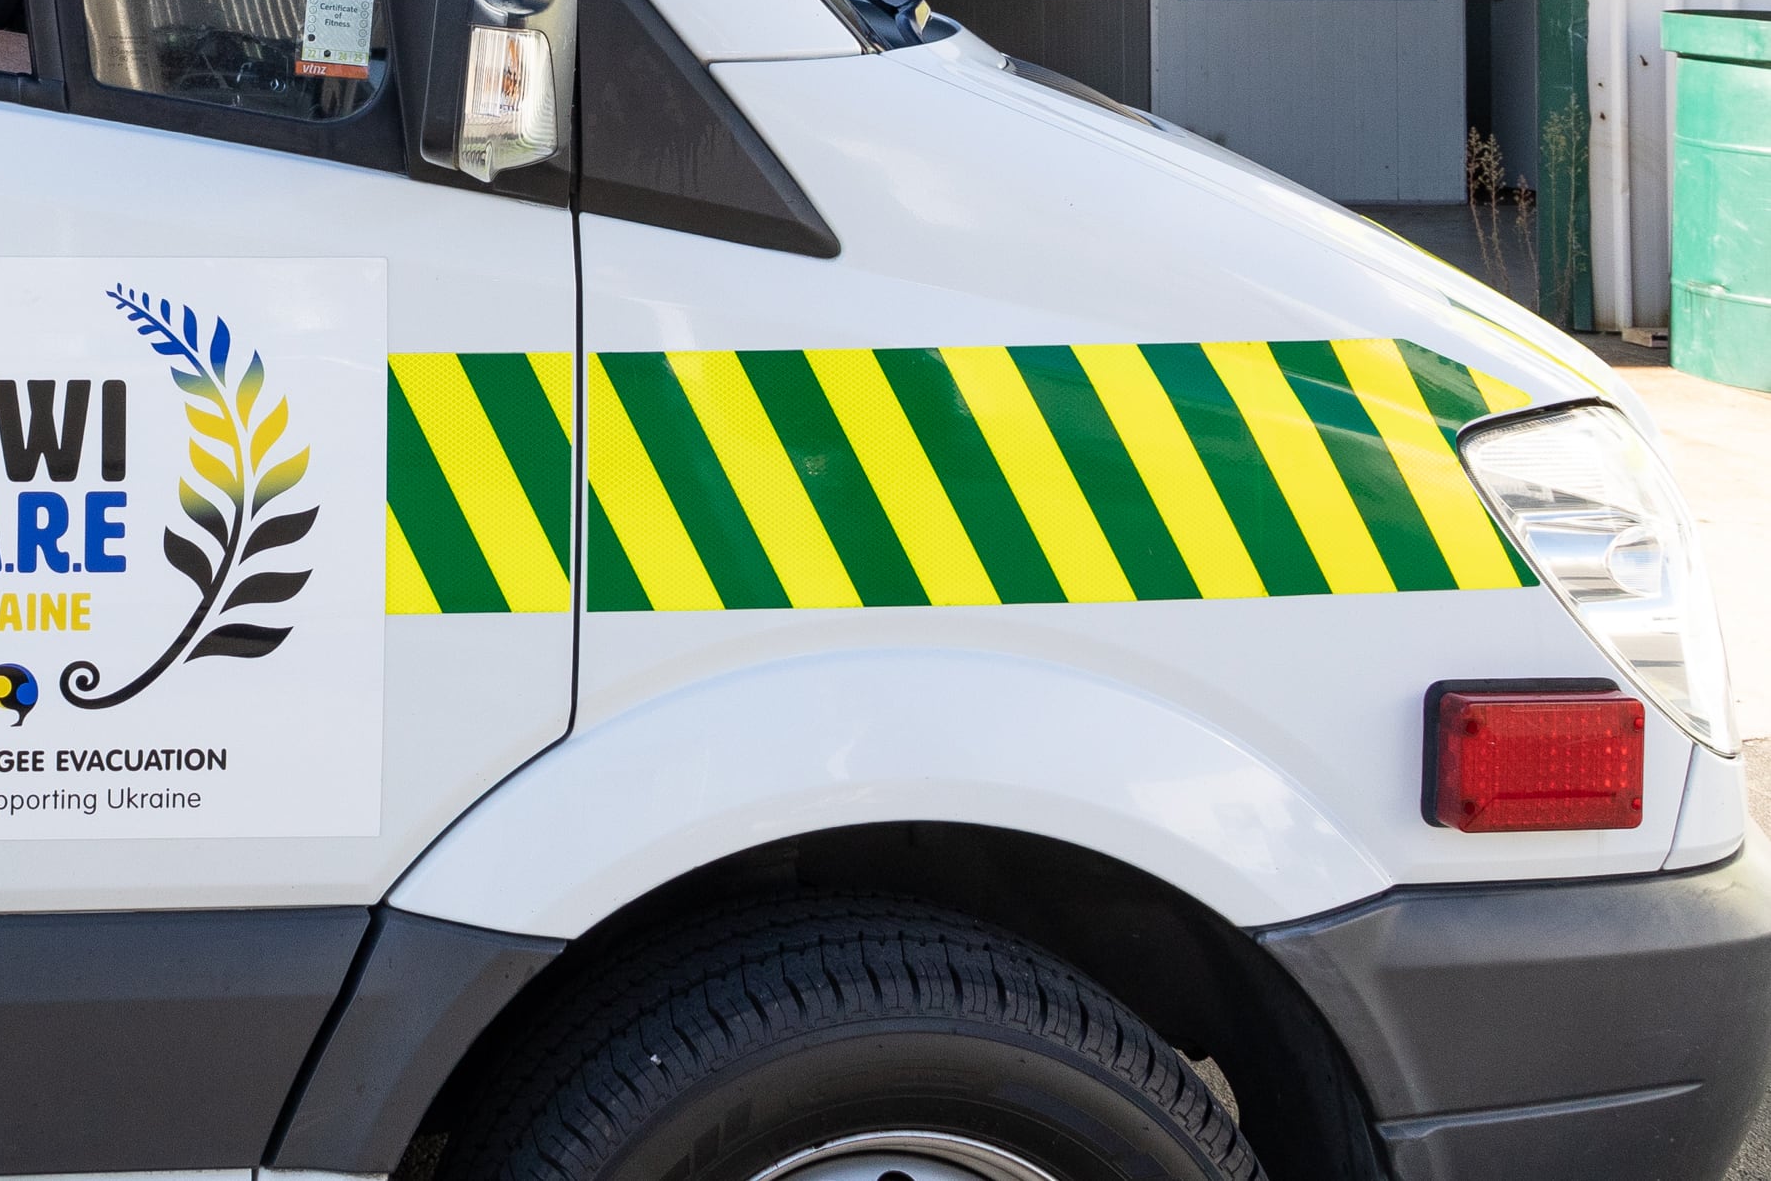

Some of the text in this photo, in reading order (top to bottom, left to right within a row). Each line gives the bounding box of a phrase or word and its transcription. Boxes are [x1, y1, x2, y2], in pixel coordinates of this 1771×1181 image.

[320, 3, 358, 13] Certificate
[324, 19, 350, 27] Fitness
[302, 64, 327, 75] vtnz
[56, 748, 227, 772] EVACUATION
[107, 787, 202, 810] Ukraine
